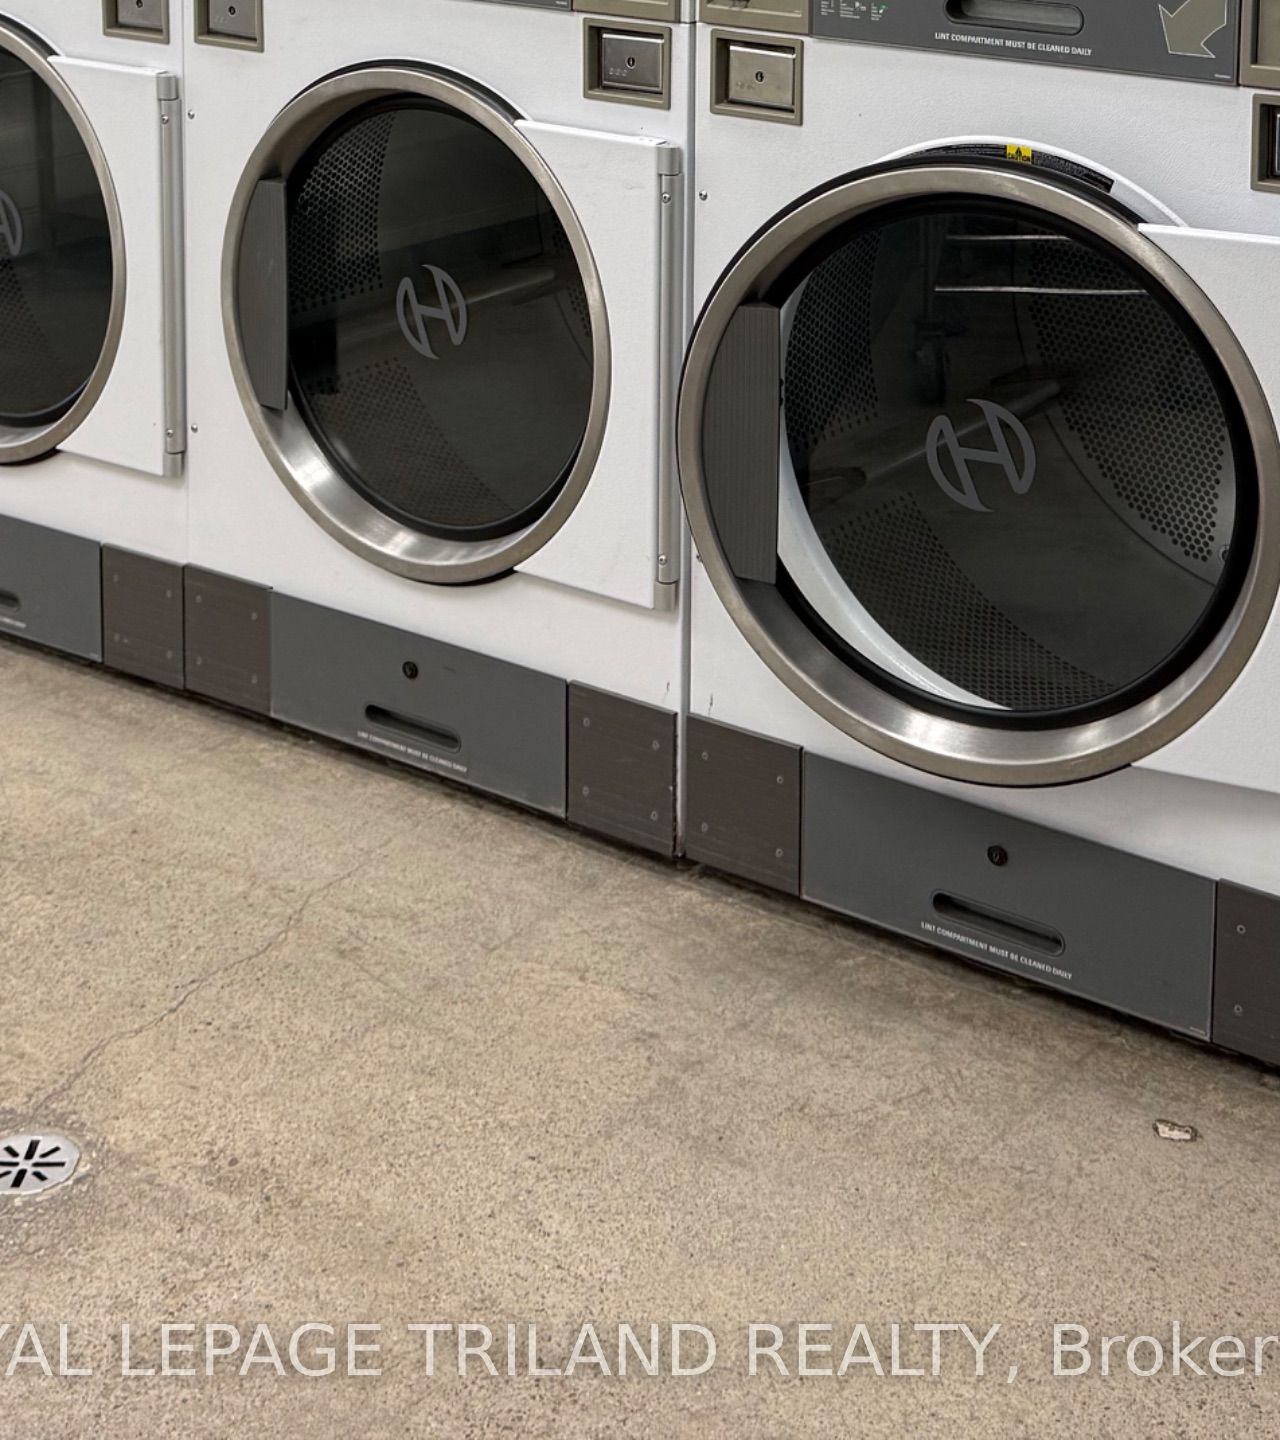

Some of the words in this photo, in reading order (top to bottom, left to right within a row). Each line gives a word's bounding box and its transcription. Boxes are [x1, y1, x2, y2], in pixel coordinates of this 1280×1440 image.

[934, 31, 950, 41] LINT
[950, 33, 1004, 47] COMPARTMENT
[1005, 39, 1026, 49] MUST
[1026, 41, 1036, 50] BE
[1037, 43, 1070, 54] CLEANED
[1071, 47, 1093, 57] DAILY
[920, 921, 936, 933] LINT
[936, 927, 988, 951] COMPARTMENT
[988, 944, 1009, 958] MUST
[1009, 952, 1019, 961] BE
[1020, 956, 1052, 973] CLEANED
